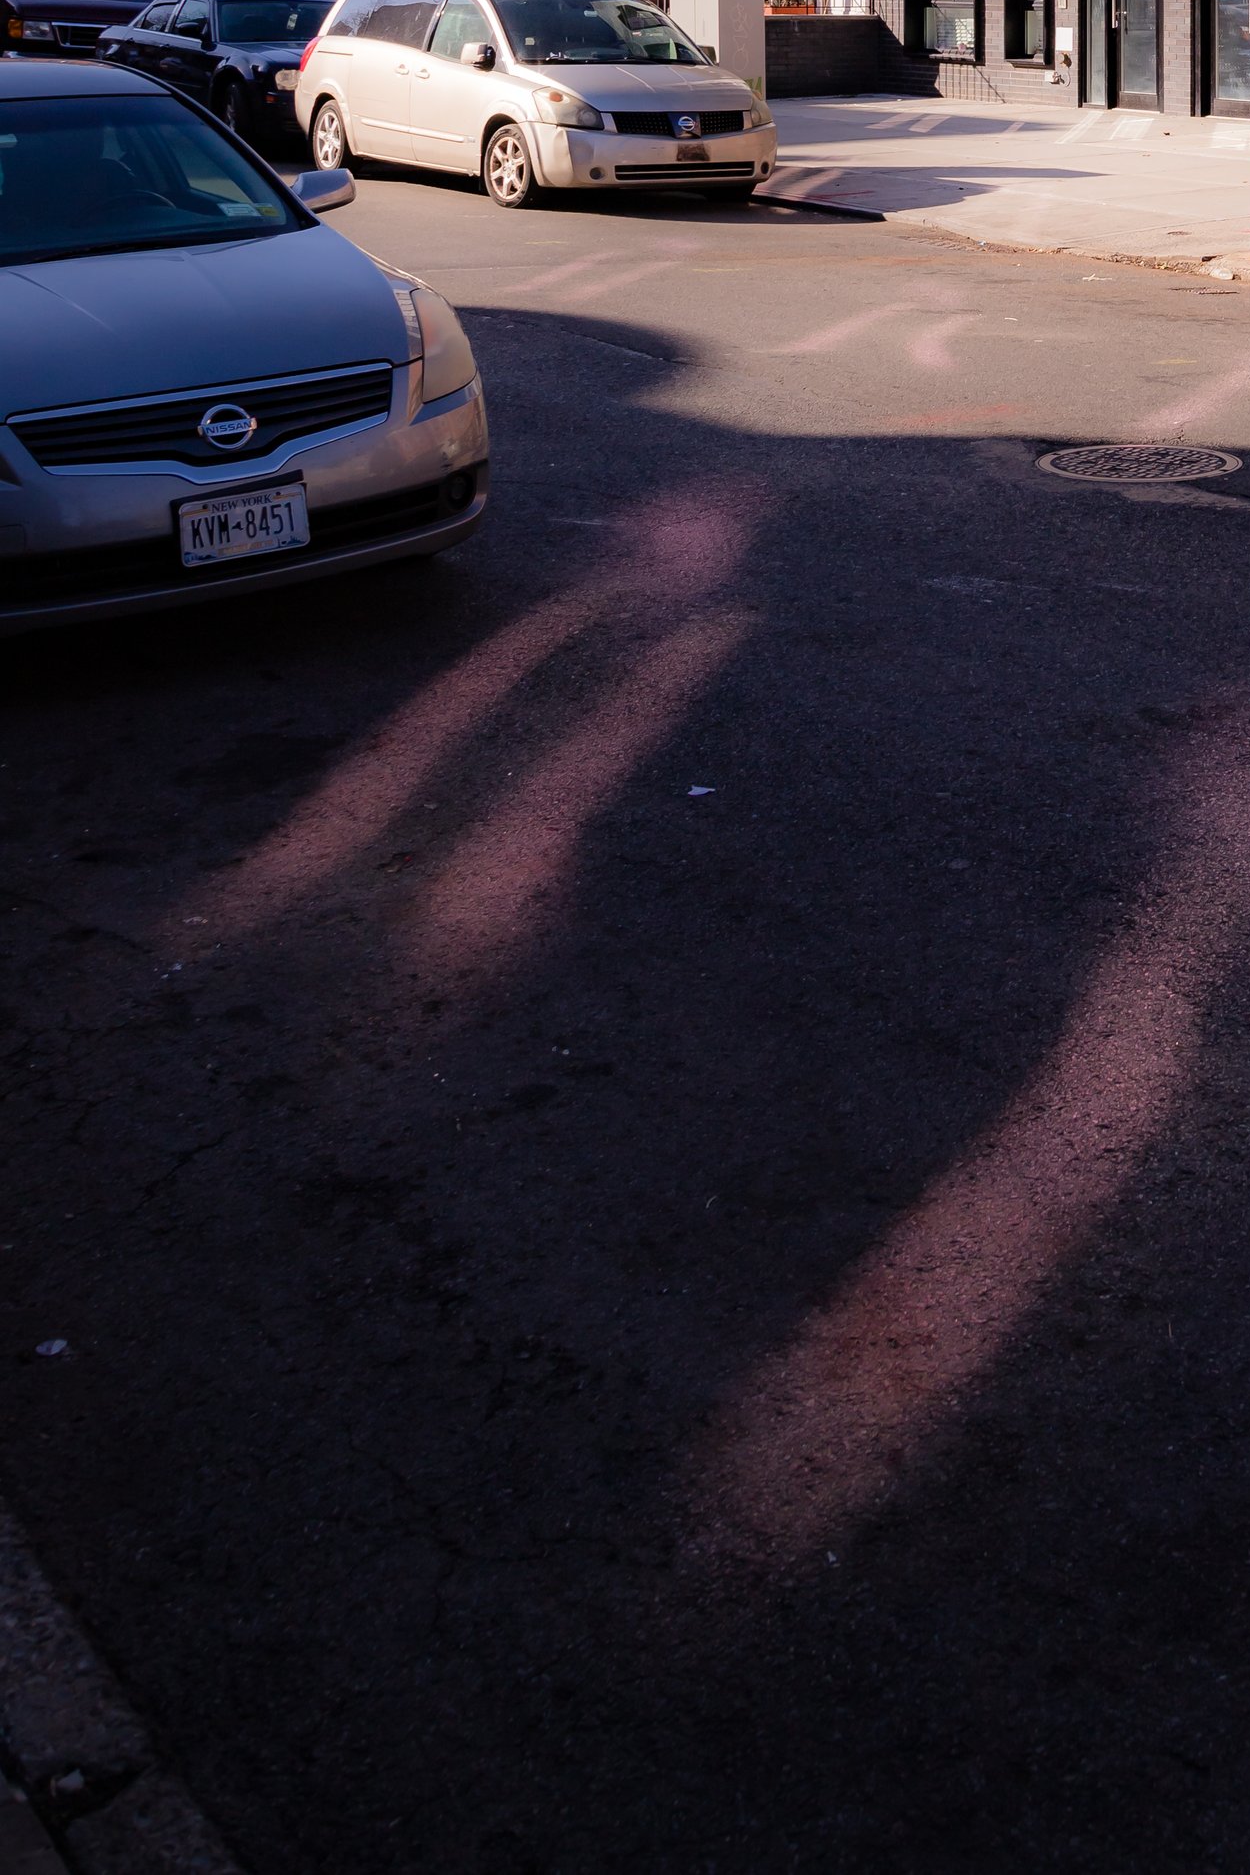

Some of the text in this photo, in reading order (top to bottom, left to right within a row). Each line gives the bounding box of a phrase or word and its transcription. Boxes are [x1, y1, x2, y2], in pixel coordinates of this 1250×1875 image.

[205, 421, 251, 435] NISSAN
[211, 493, 273, 513] NEW YORK
